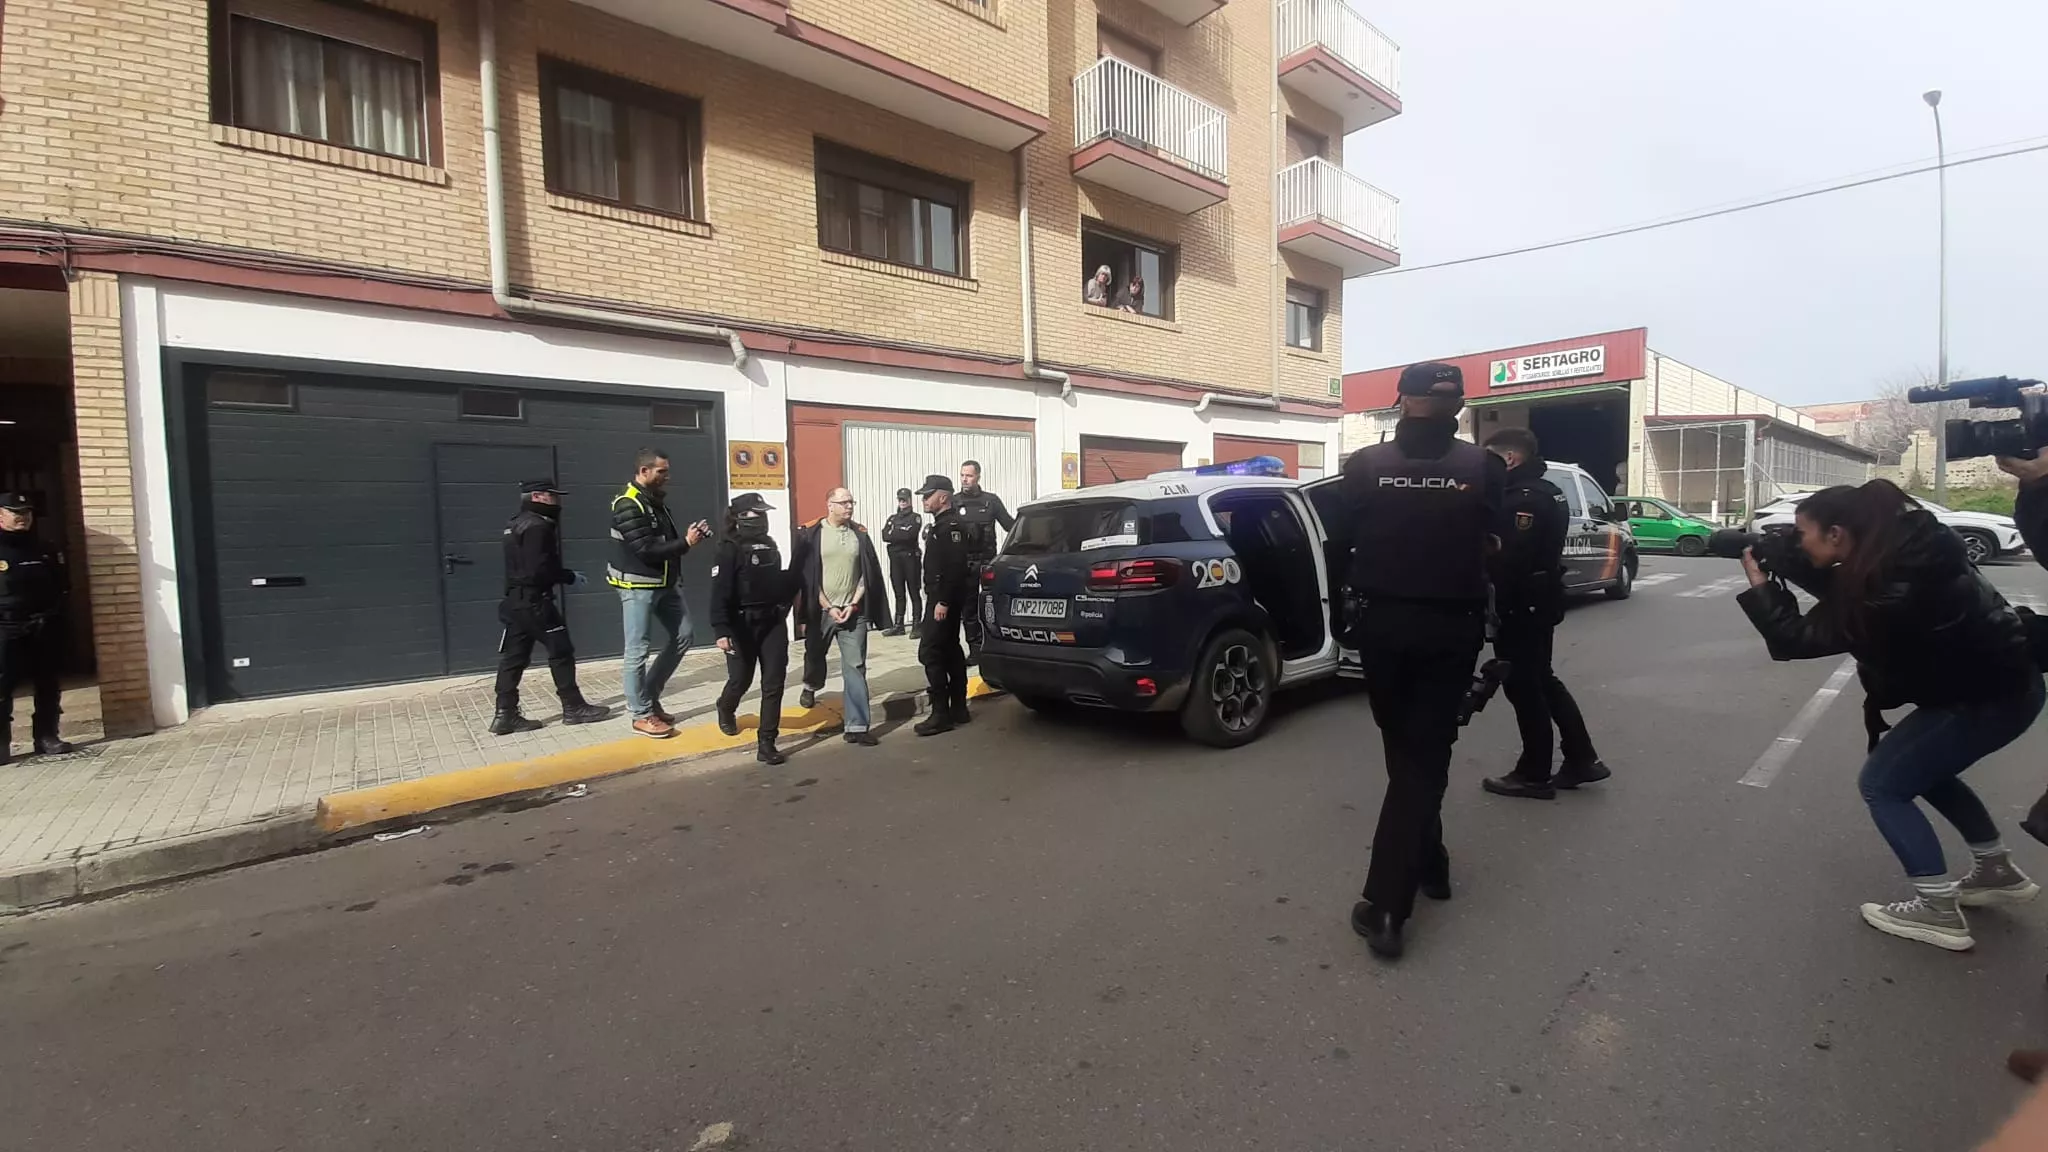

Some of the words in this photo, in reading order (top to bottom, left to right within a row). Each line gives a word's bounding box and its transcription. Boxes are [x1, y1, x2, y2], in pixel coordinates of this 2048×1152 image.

[1523, 349, 1600, 371] SERTAGRO
[1160, 484, 1190, 496] 2LM
[1378, 477, 1458, 488] POLICIA
[1191, 558, 1241, 589] 200
[1000, 626, 1060, 643] POLICIA
